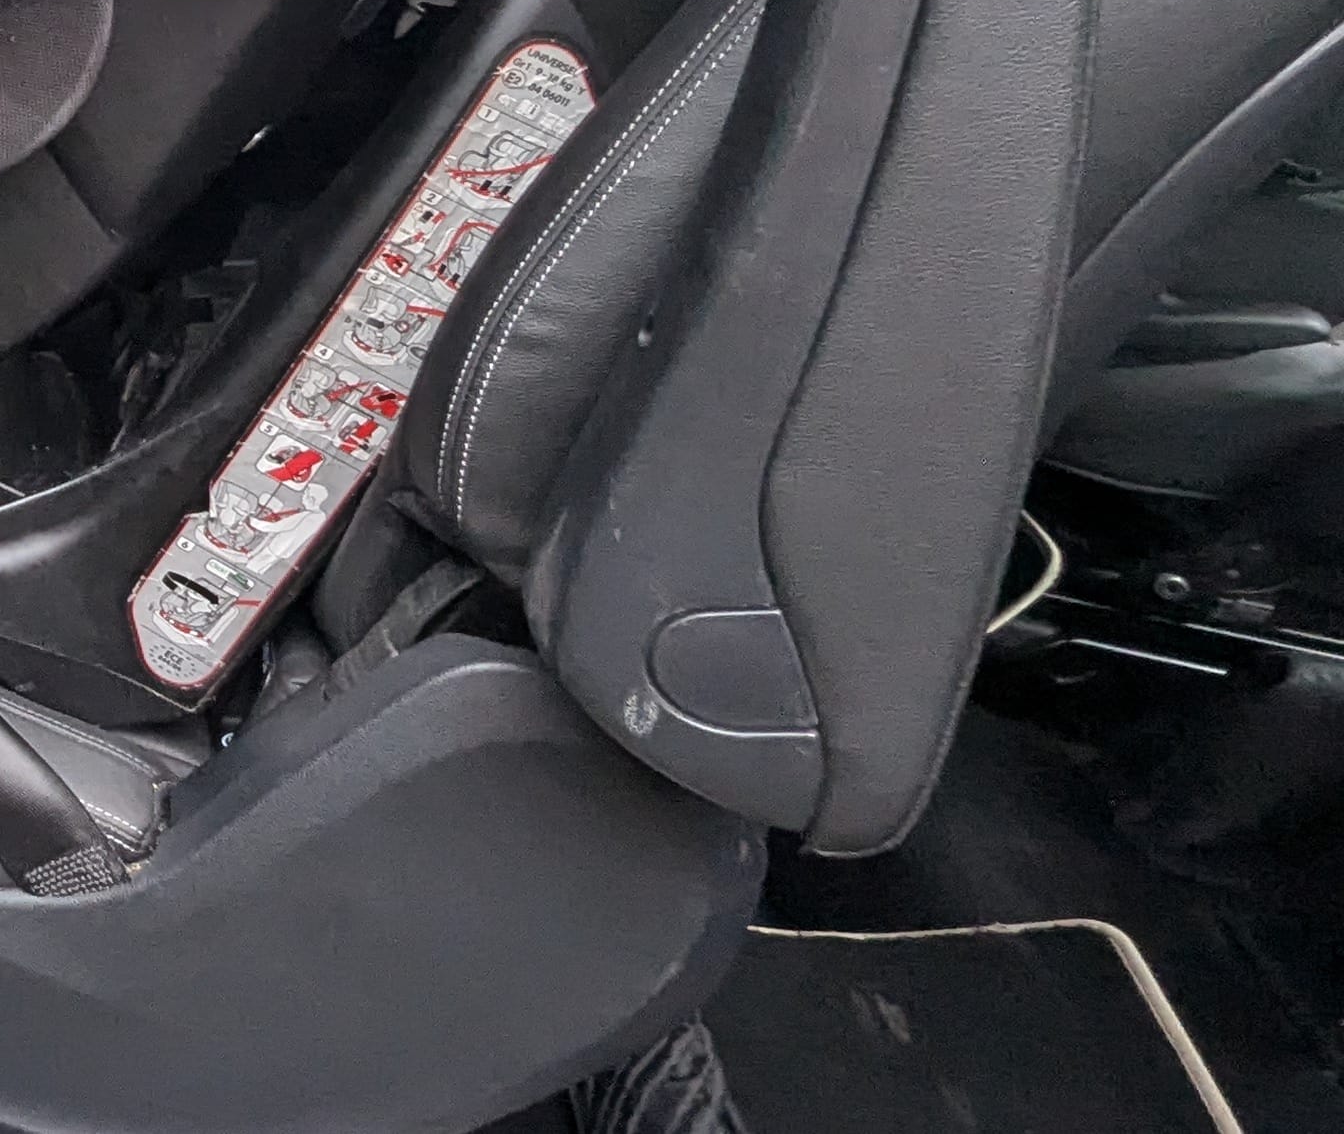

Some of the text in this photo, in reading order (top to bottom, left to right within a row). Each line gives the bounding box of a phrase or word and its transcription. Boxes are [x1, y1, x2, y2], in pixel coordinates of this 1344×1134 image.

[503, 72, 522, 85] E2
[559, 78, 574, 92] kg
[426, 192, 435, 202] 2
[318, 347, 328, 357] 4
[263, 423, 274, 433] 5
[180, 540, 189, 549] 6
[164, 650, 185, 665] ECE
